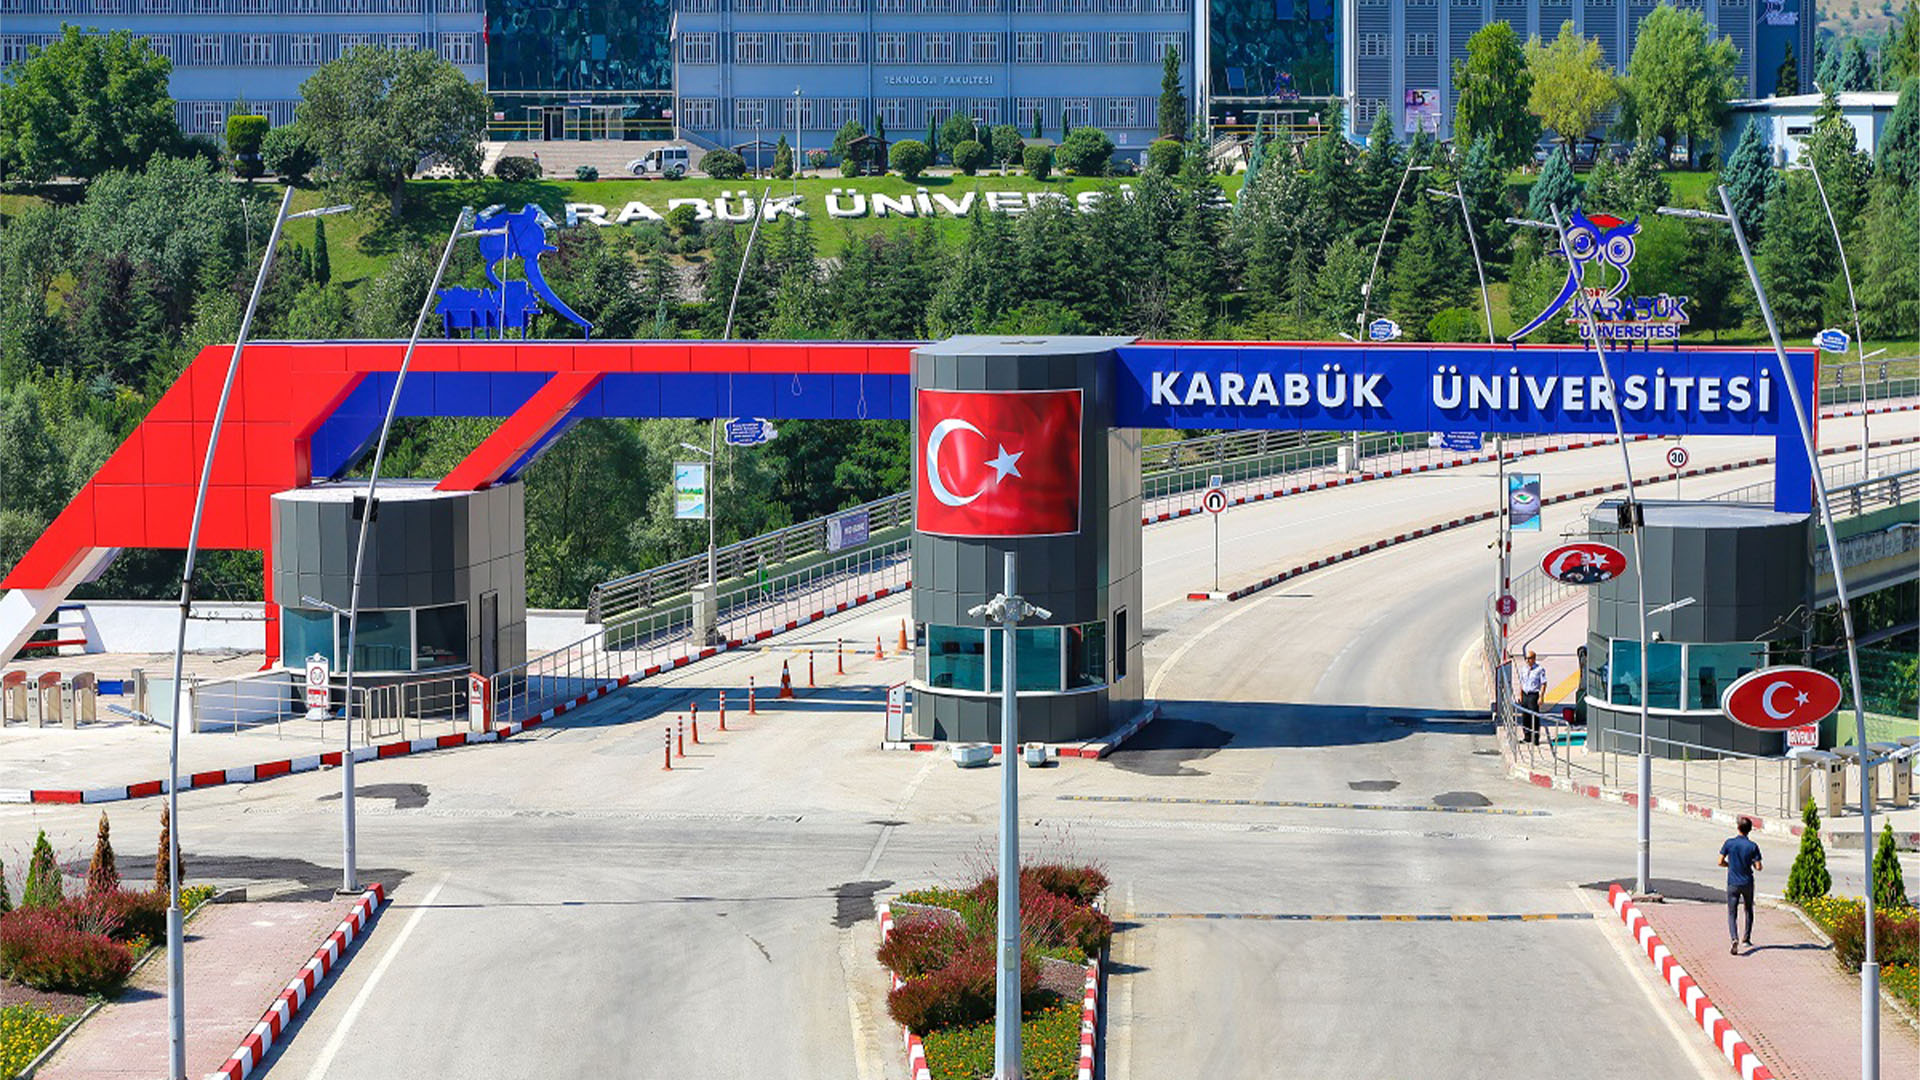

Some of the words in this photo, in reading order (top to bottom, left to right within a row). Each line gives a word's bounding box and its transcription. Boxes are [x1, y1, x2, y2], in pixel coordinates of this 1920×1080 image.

[943, 75, 993, 85] FAKÜLTESİ
[1571, 293, 1689, 321] KARABÜK
[1151, 363, 1384, 408] KARABÜK
[1432, 365, 1771, 412] ÜNİVERSİTESİ
[1671, 452, 1684, 463] 30
